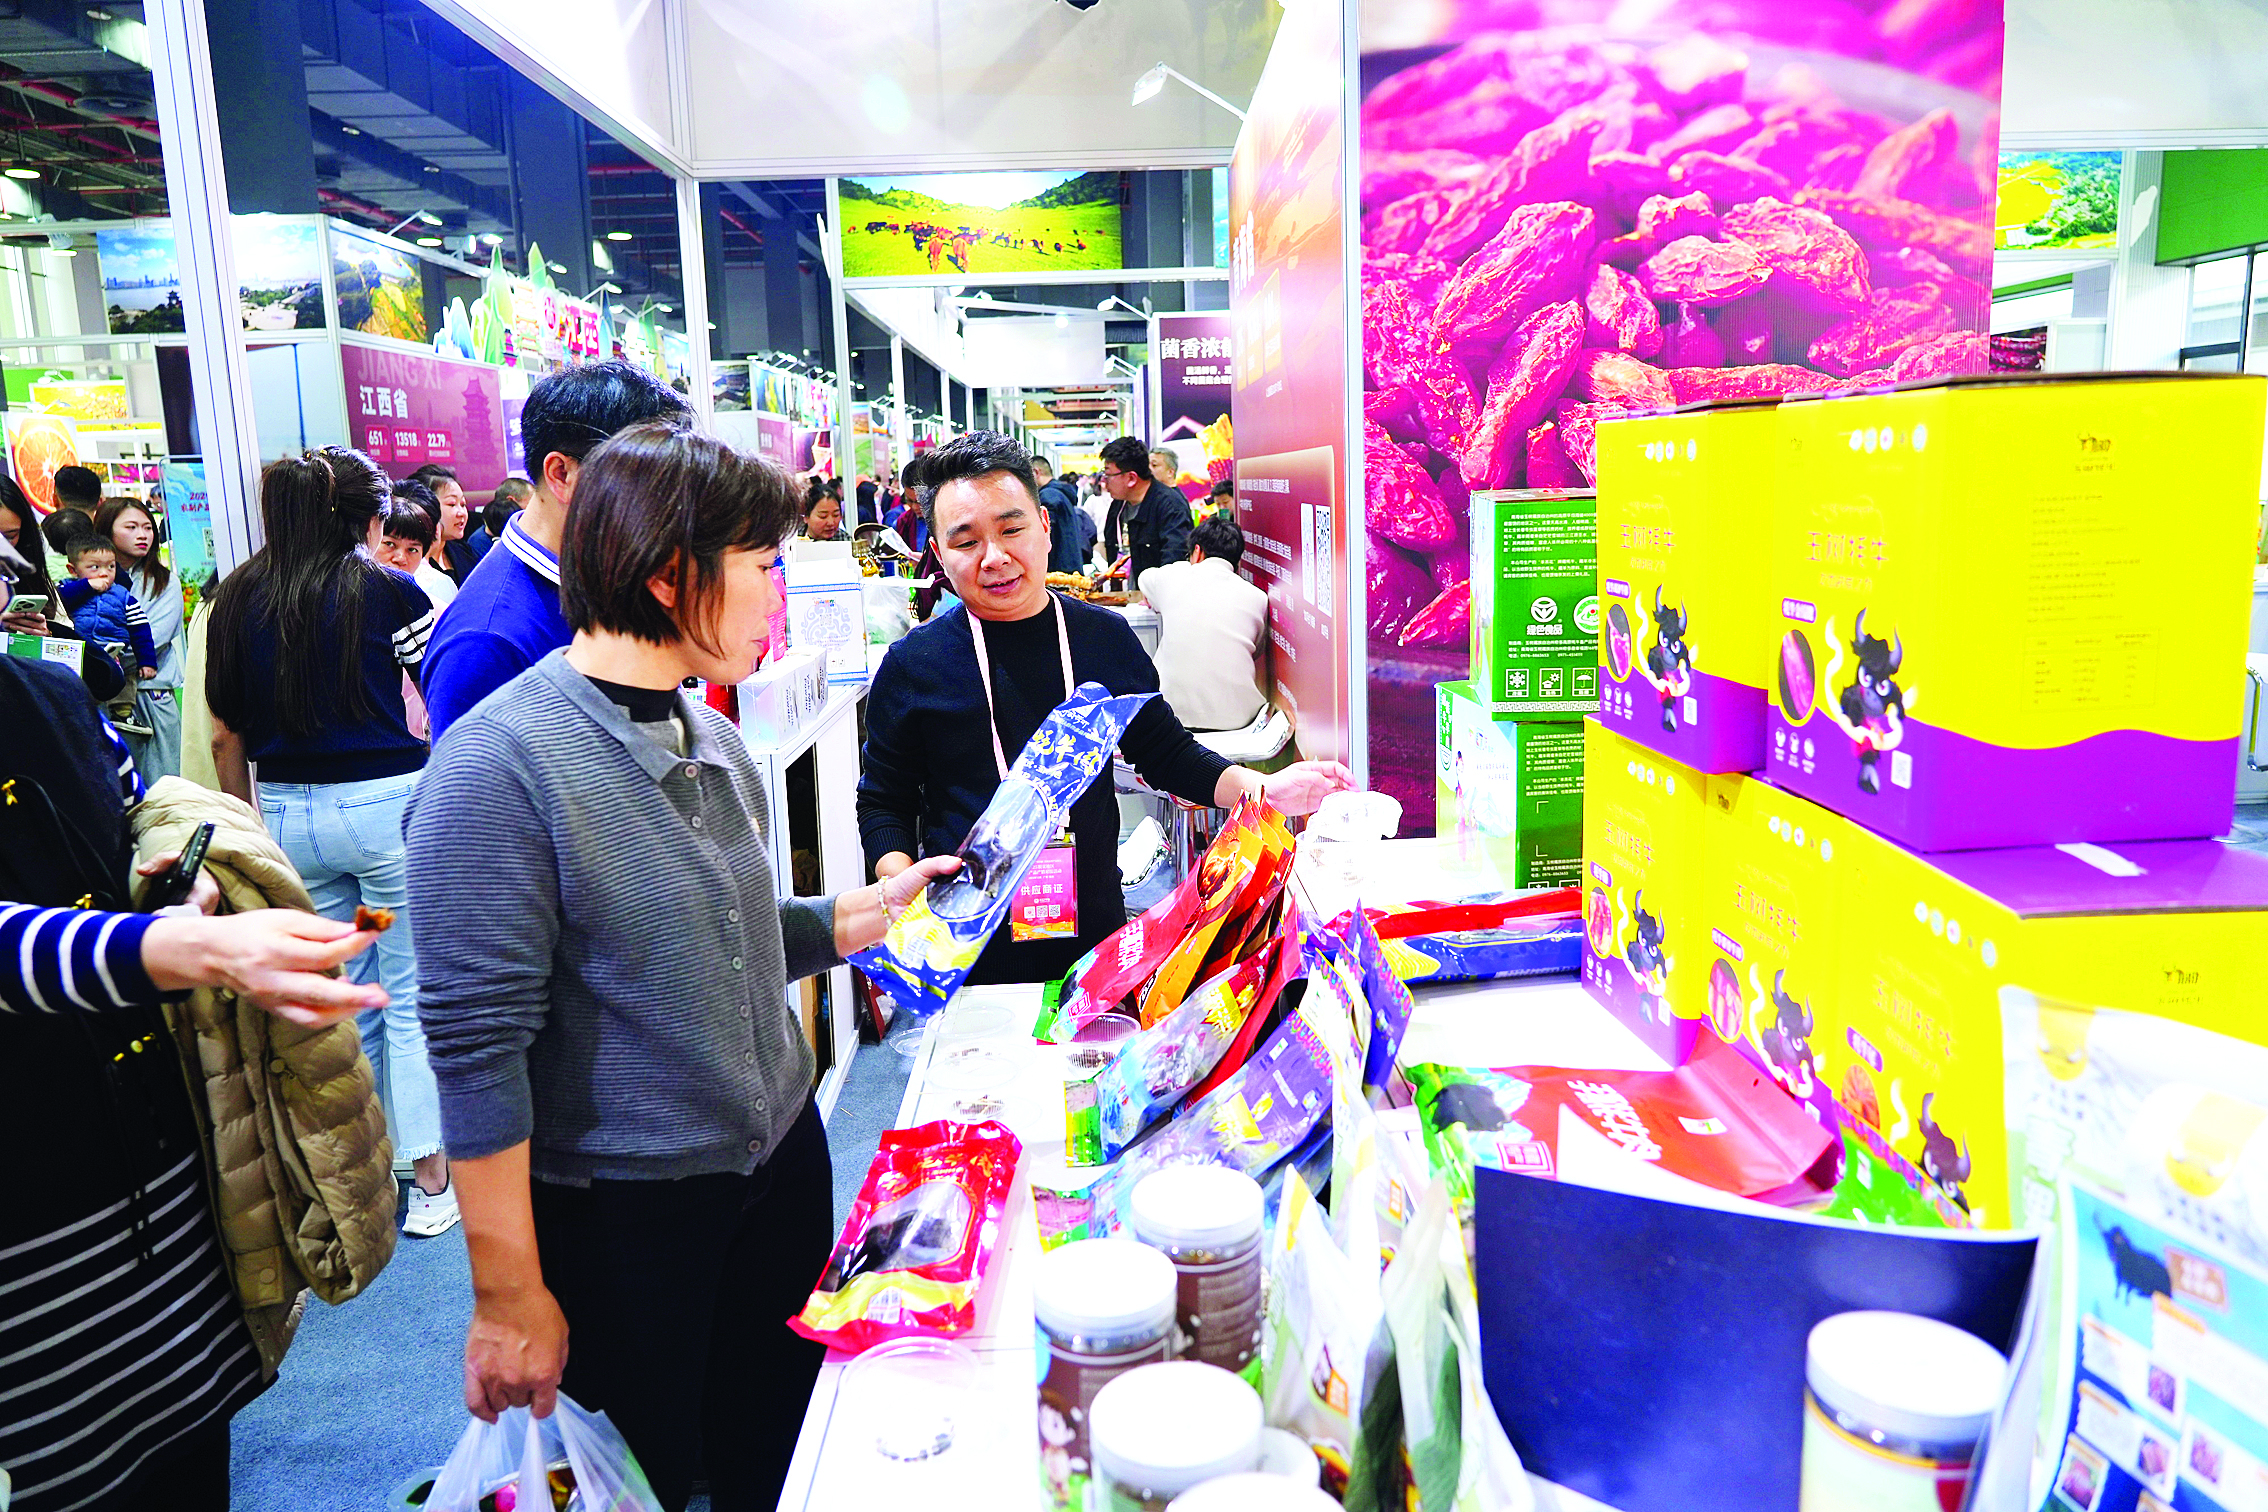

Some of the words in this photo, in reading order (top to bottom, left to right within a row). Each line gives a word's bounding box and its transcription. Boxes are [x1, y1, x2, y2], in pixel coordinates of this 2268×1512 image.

[358, 346, 419, 388] JIANG
[423, 358, 442, 391] XI
[359, 384, 409, 420] 江西省
[368, 430, 384, 446] 651
[394, 431, 418, 447] 13518
[427, 432, 447, 448] 22.79
[1805, 531, 1890, 571] 玉树牦牛
[1526, 623, 1563, 636] 绿色食品
[1020, 883, 1064, 896] 供应商证
